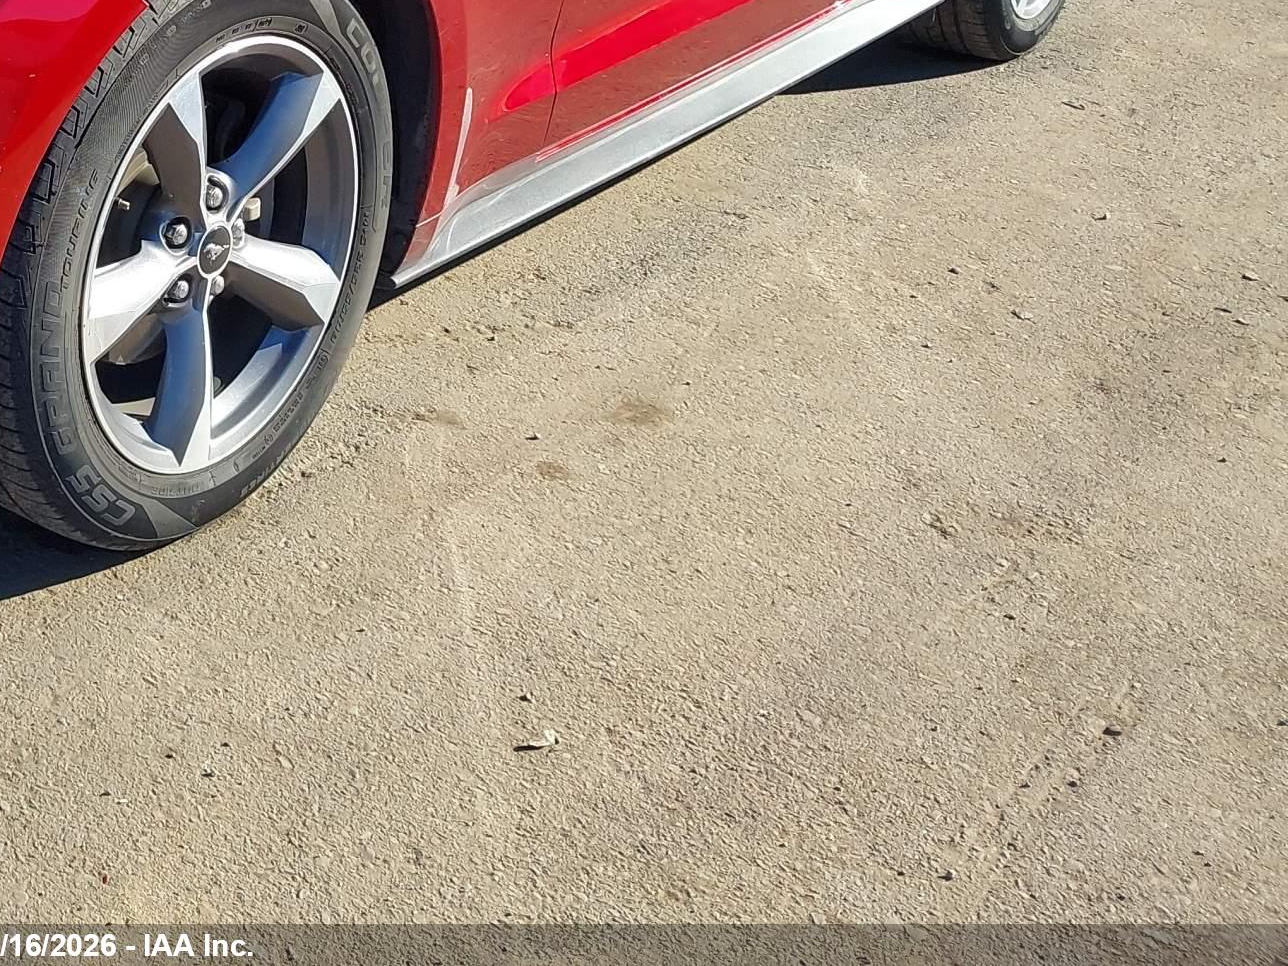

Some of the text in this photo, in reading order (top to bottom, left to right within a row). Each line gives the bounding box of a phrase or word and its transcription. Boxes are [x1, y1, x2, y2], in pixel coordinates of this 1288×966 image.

[346, 17, 391, 209] COER
[40, 168, 136, 527] CS5 GRAND TOURING
